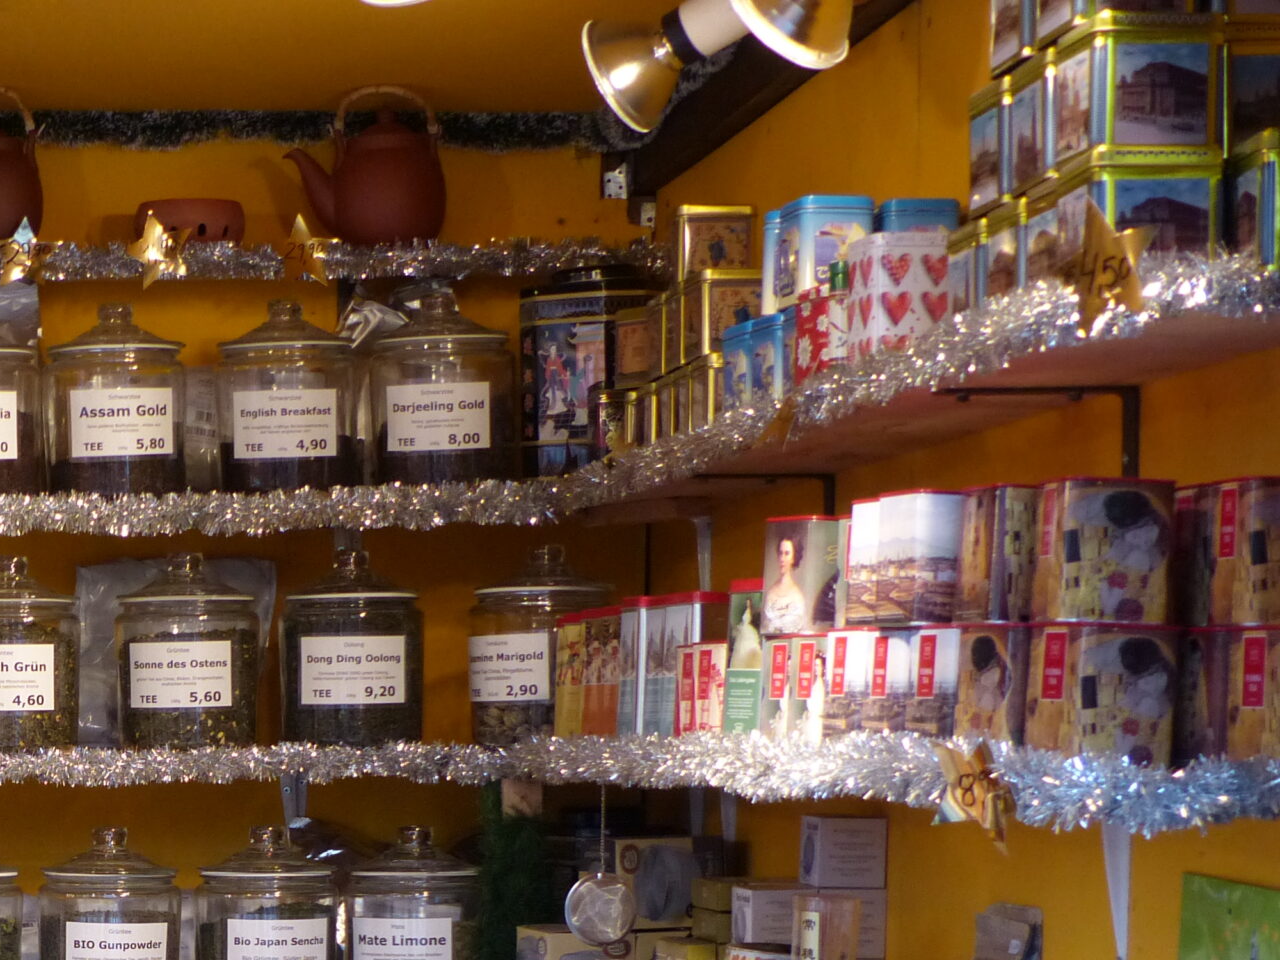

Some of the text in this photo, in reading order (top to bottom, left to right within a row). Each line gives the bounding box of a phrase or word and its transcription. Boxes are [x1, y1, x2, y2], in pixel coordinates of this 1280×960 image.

[79, 403, 167, 419] Assam Gold
[240, 405, 332, 420] English Breakfast
[392, 399, 485, 415] Darjeeling Gold
[83, 437, 165, 452] TEE 5,80
[295, 438, 328, 453] 4,90
[447, 432, 481, 447] 8,00
[133, 658, 228, 670] Sonne des Ostens
[306, 653, 401, 666] Dong Ding Oolong
[496, 651, 544, 663] Marigold
[13, 661, 47, 673] Grün
[139, 690, 222, 705] TEE 5,60
[312, 685, 396, 700] TEE 9,20
[505, 683, 539, 699] 2,90
[11, 694, 45, 709] 4,60
[73, 939, 163, 952] BIO Gunpowder
[233, 935, 324, 949] Bio Japan Sencha
[358, 933, 447, 947] Mate Limone
